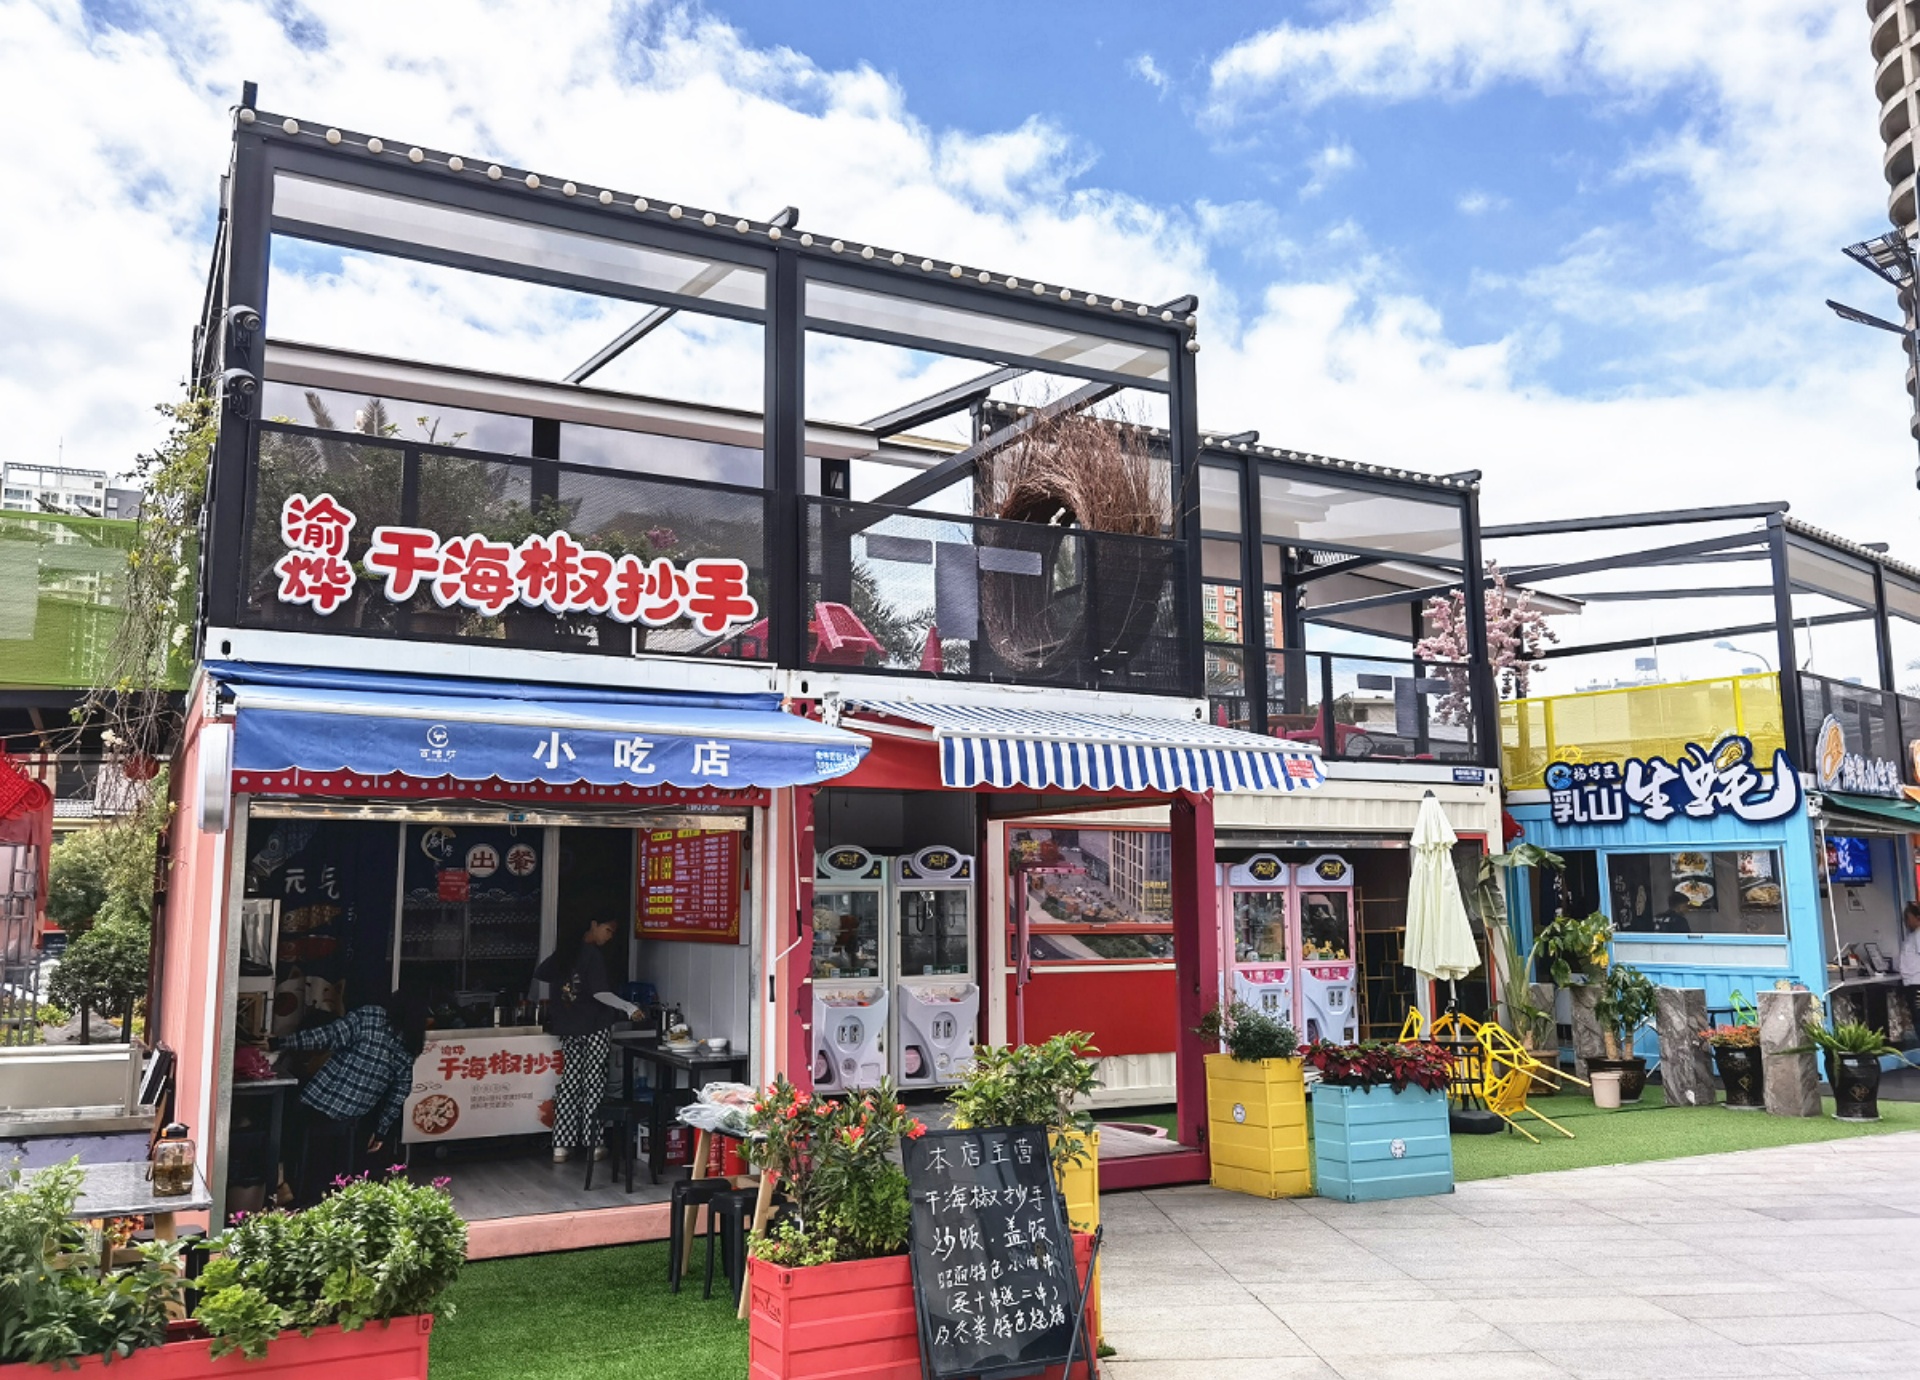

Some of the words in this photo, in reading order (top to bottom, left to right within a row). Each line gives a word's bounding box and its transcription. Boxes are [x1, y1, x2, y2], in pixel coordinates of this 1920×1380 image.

[369, 530, 756, 634] 干海椒抄手
[532, 732, 731, 777] 小吃店
[1551, 788, 1623, 824] 乳山
[1626, 743, 1797, 821] 生蚝
[924, 1137, 1032, 1174] 本店主营
[925, 1184, 1046, 1216] 干海椒抄手
